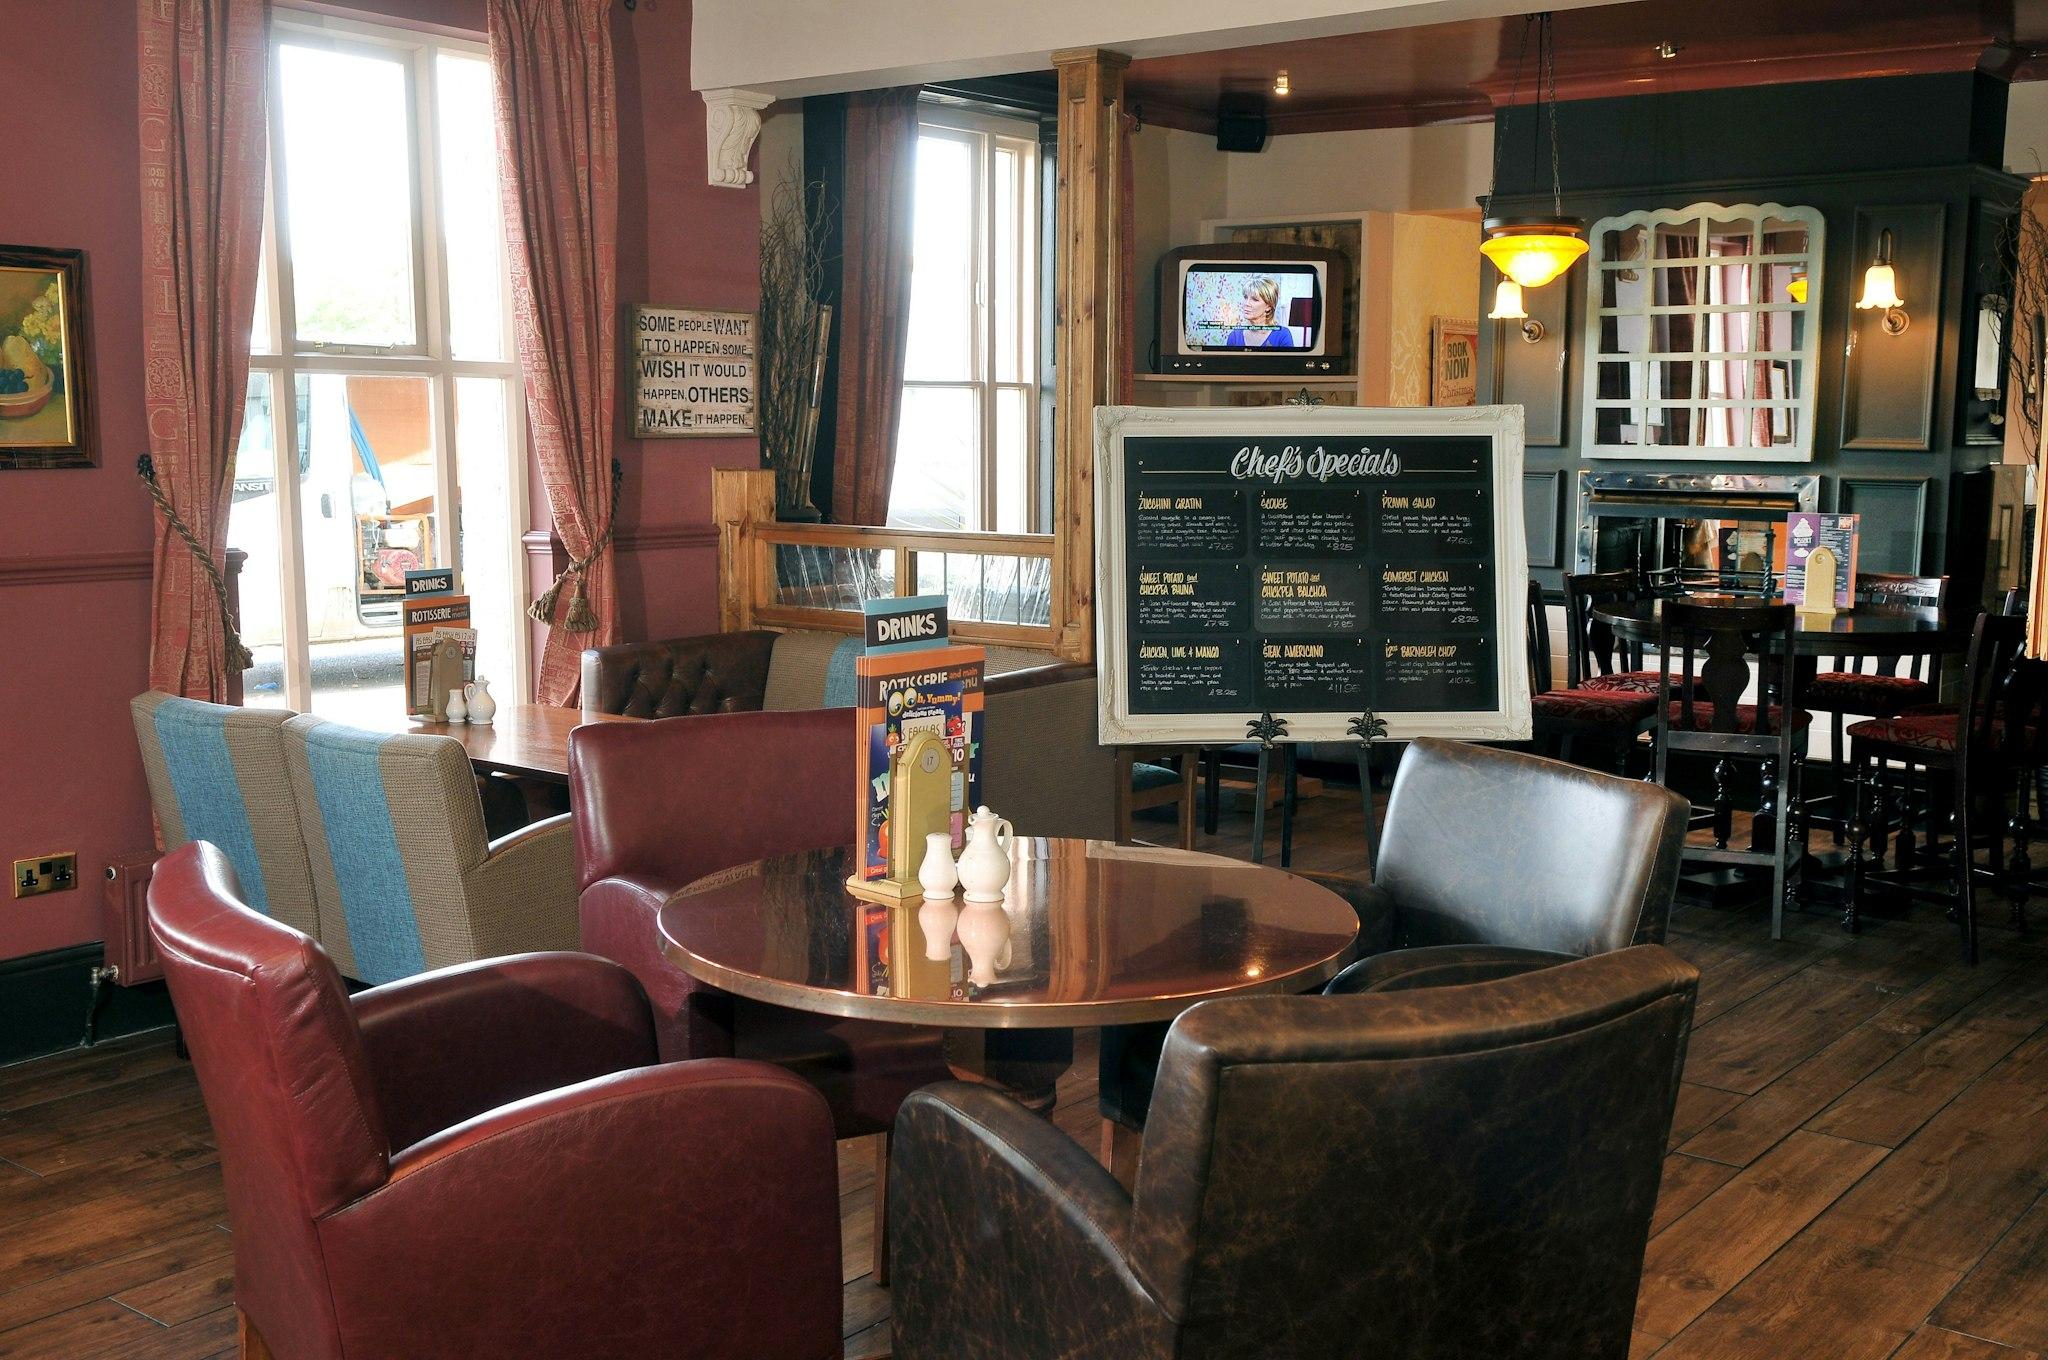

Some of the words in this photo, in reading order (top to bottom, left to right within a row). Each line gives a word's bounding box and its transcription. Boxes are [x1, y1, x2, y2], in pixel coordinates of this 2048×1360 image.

[639, 315, 675, 332] SOME
[678, 320, 712, 332] PEOPLE
[713, 318, 749, 335] WANT
[641, 338, 651, 352] IT
[655, 339, 670, 353] TO
[722, 344, 746, 355] SOME
[1447, 341, 1467, 358] BOOK
[641, 359, 685, 378] WISH
[689, 364, 699, 376] IT
[703, 364, 746, 377] WOULD
[1445, 357, 1469, 380] NOW
[688, 386, 748, 403] OTHERS
[642, 409, 692, 427] MAKE
[695, 414, 703, 424] IT
[1230, 445, 1303, 483] Chef's
[1306, 446, 1400, 482] Specials
[1138, 497, 1171, 510] ZUCCHINI
[1175, 497, 1202, 509] GRATIN
[1260, 497, 1288, 509] SCOUSE
[1381, 496, 1408, 508] PRAWN
[1412, 497, 1435, 508] SALAD
[1139, 572, 1160, 584] SWEET
[1163, 572, 1184, 583] POTATO
[1186, 573, 1198, 583] and
[1261, 571, 1284, 584] SWEET
[1286, 571, 1309, 584] POTATO
[1382, 570, 1417, 582] SOMERSET
[1419, 570, 1449, 582] CHICKEN
[411, 577, 447, 592] DRINKS
[1139, 584, 1169, 595] CHICKPEA
[1171, 584, 1194, 595] BHUNA
[1261, 585, 1294, 598] CHICKPEA
[411, 608, 451, 622] ROTISSERIE
[877, 613, 937, 641] DRINKS
[1171, 646, 1186, 658] LIME
[1195, 646, 1219, 658] MANGO
[1262, 644, 1281, 658] STEAK
[1284, 644, 1324, 658] AMERICANO
[1401, 645, 1437, 658] BARNSLEY
[1438, 645, 1456, 658] CHOP
[948, 669, 961, 678] and
[962, 668, 977, 676] main
[962, 677, 977, 688] nu
[927, 692, 960, 706] Yummy!
[902, 710, 927, 718] delicious
[930, 723, 940, 736] AS
